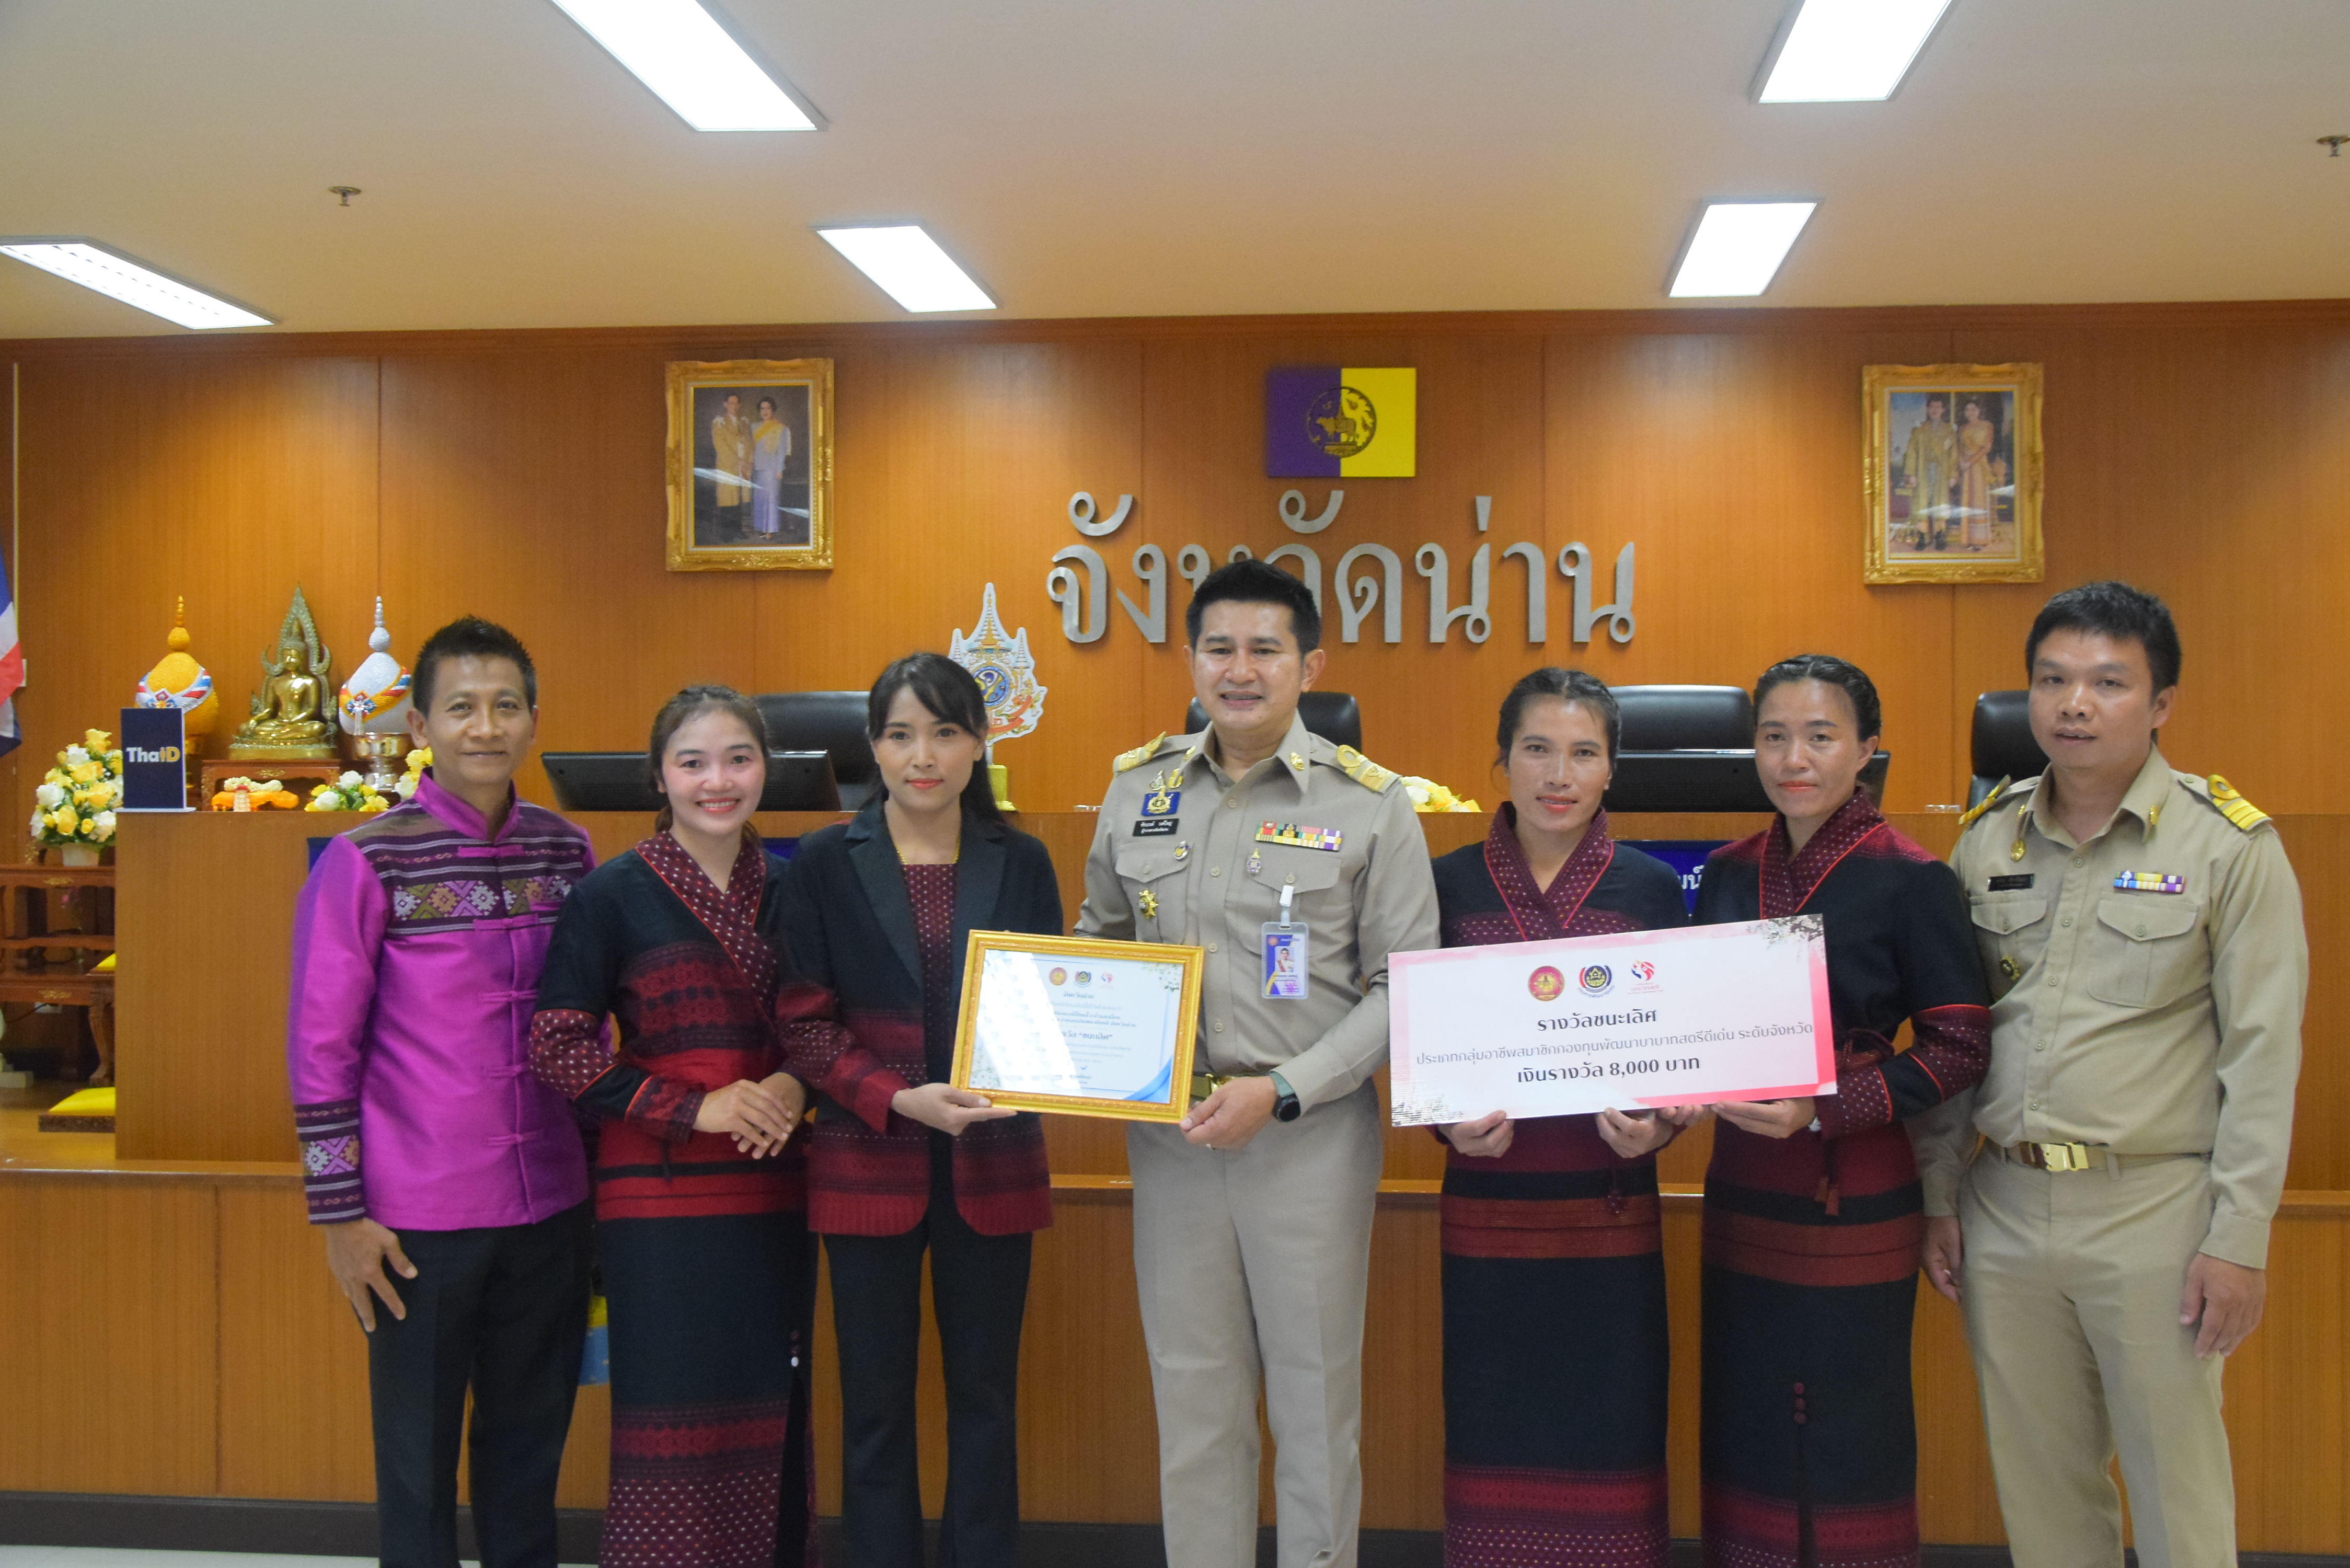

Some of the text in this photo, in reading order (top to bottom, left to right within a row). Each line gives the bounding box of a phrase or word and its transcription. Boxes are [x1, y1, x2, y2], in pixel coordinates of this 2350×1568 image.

[125, 746, 181, 763] ThaiD
[1537, 1008, 1657, 1031] รางวัลชนะเลิศ
[1738, 1022, 1813, 1040] ระดับจังหวัด
[1517, 1057, 1700, 1083] เงินรางวัล 8,000 บาท
